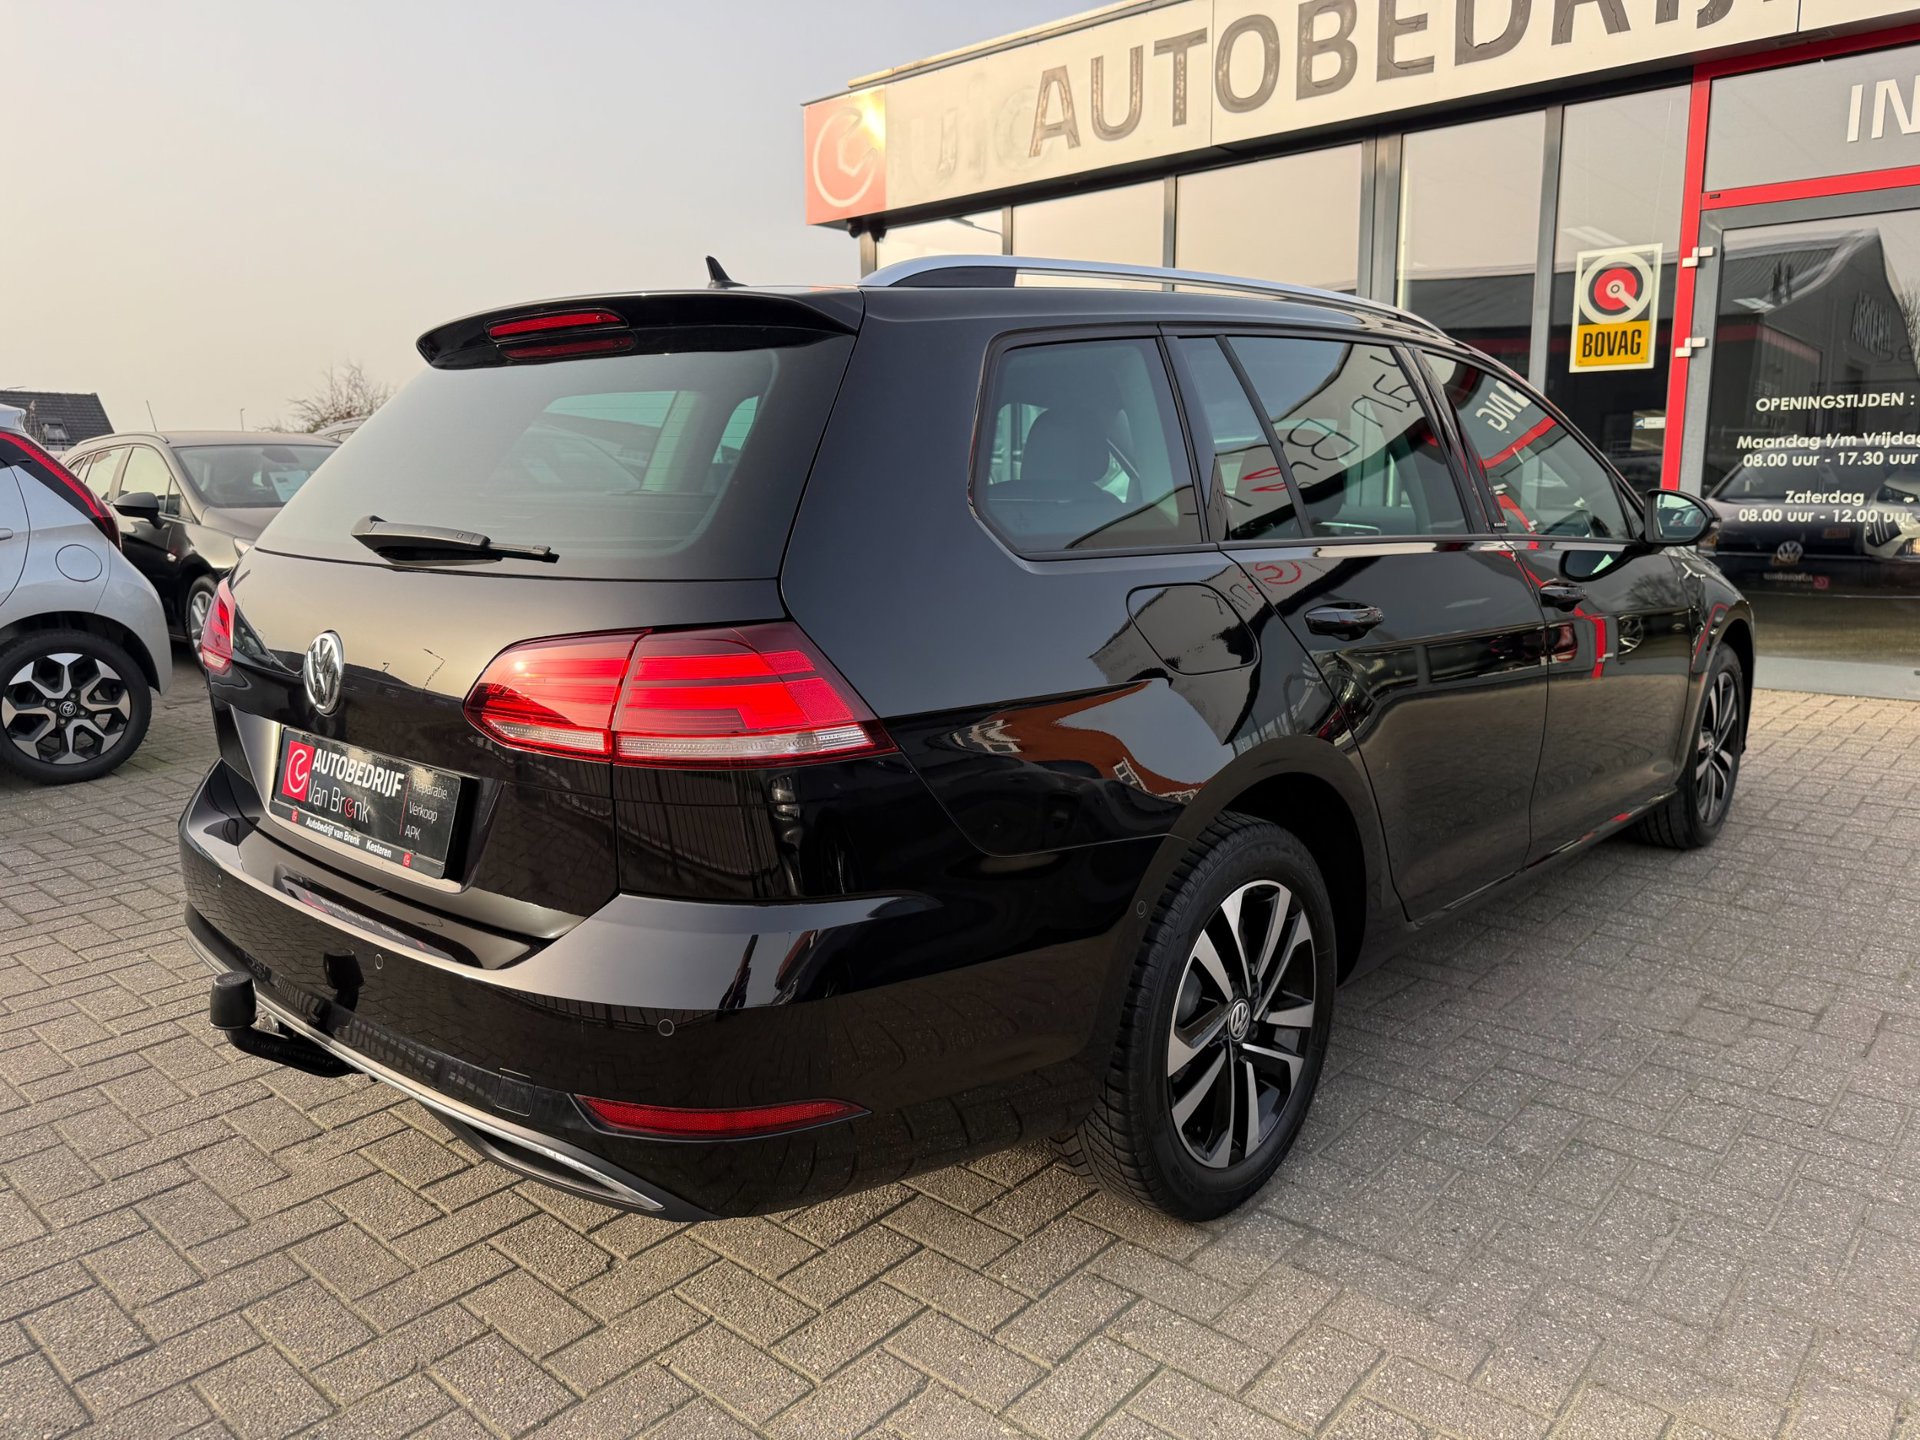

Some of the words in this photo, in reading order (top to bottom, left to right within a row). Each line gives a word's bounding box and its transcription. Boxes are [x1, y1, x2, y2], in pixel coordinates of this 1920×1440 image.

[1028, 0, 1773, 158] AUTOBED
[1582, 329, 1642, 358] BOVAG
[1755, 392, 1905, 411] OPENINGSTIJDEN
[1736, 434, 1821, 450] Maandag
[1825, 433, 1857, 449] t/m
[1743, 453, 1788, 467] 08.00
[1792, 456, 1820, 466] uur
[1837, 451, 1884, 465] 17.30
[1889, 453, 1919, 465] uur
[1785, 490, 1865, 506] Zaterdag
[1738, 508, 1782, 522] 08.00
[1787, 512, 1815, 522] uur
[1832, 508, 1878, 523] 12.00
[1883, 512, 1912, 523] uur
[312, 748, 405, 797] AUTOBEDRIJF
[308, 778, 328, 808] Van
[409, 801, 438, 824] Verkoop
[305, 817, 334, 837] Autobedrijf
[333, 828, 344, 839] van
[365, 839, 392, 857] Kesteren
[404, 824, 421, 840] APK
